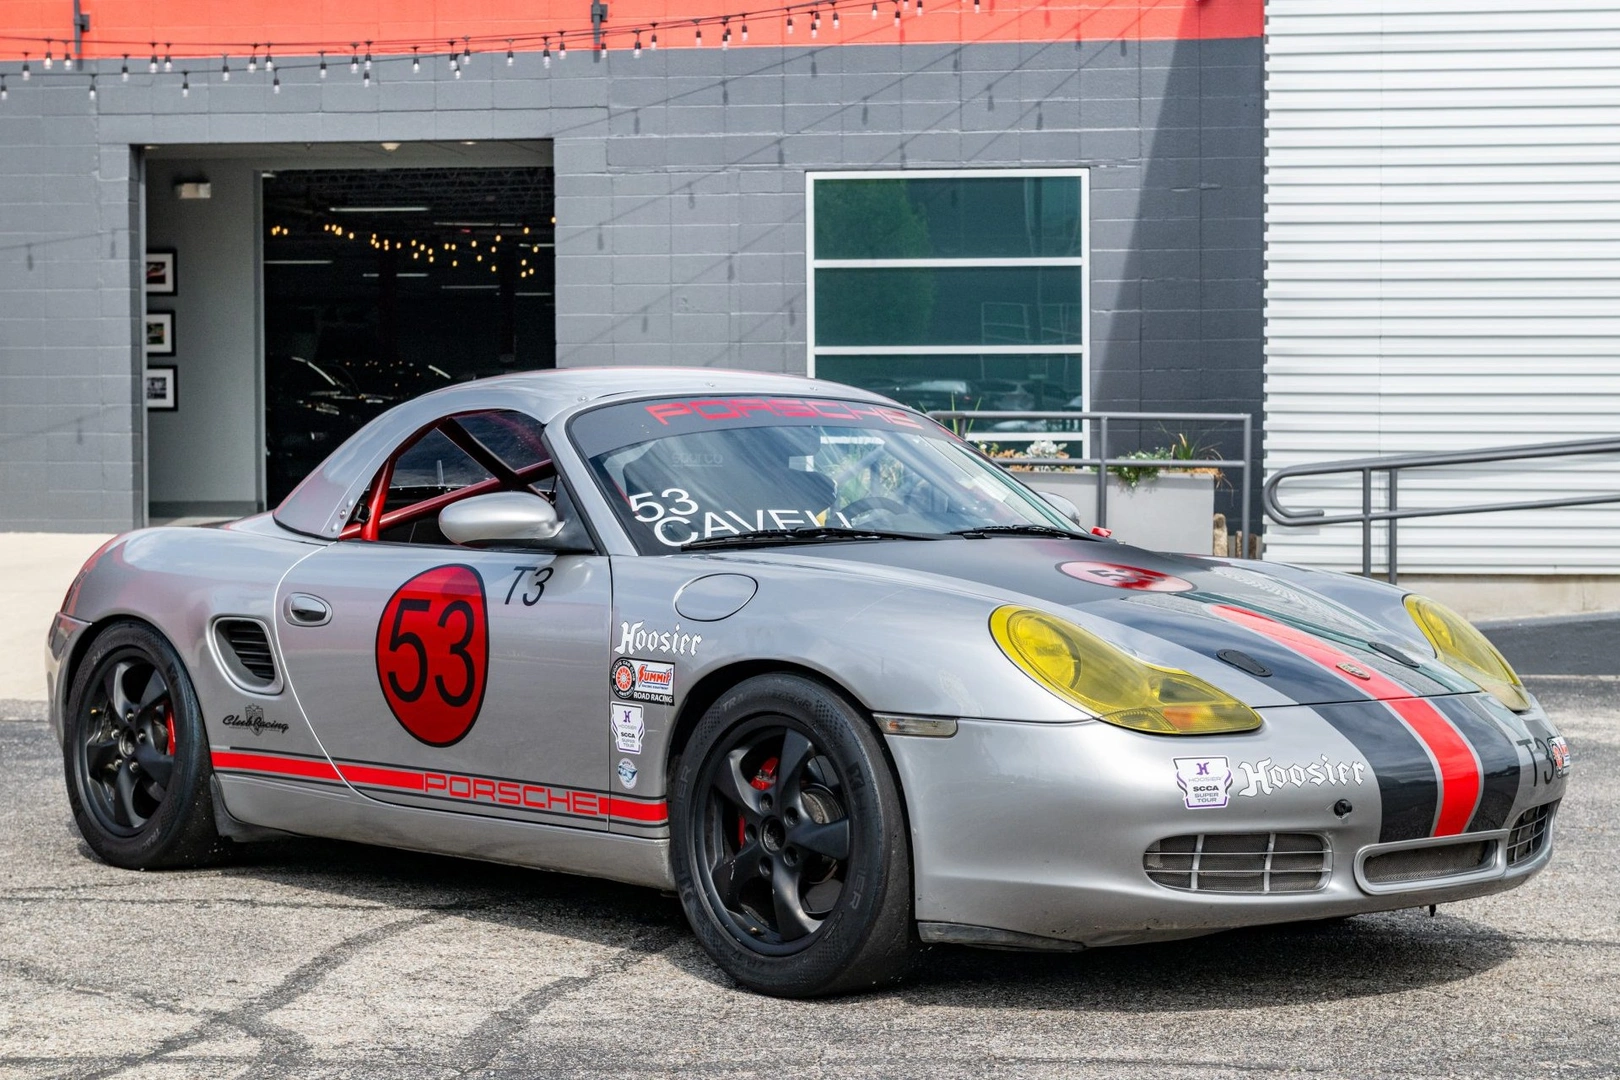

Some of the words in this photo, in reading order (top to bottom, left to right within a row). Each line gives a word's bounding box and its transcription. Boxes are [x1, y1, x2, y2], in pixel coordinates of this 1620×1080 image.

[644, 397, 925, 430] PORSCHE
[629, 488, 699, 522] 53
[504, 566, 554, 606] T3
[387, 598, 475, 707] 53
[614, 621, 702, 656] Hoosier
[633, 691, 650, 700] ROAD
[651, 694, 673, 703] RACING
[222, 714, 252, 727] Club
[252, 716, 290, 735] Racing
[1238, 754, 1365, 797] Hoosier
[1516, 738, 1554, 787] T3
[424, 773, 599, 815] PORSCHE
